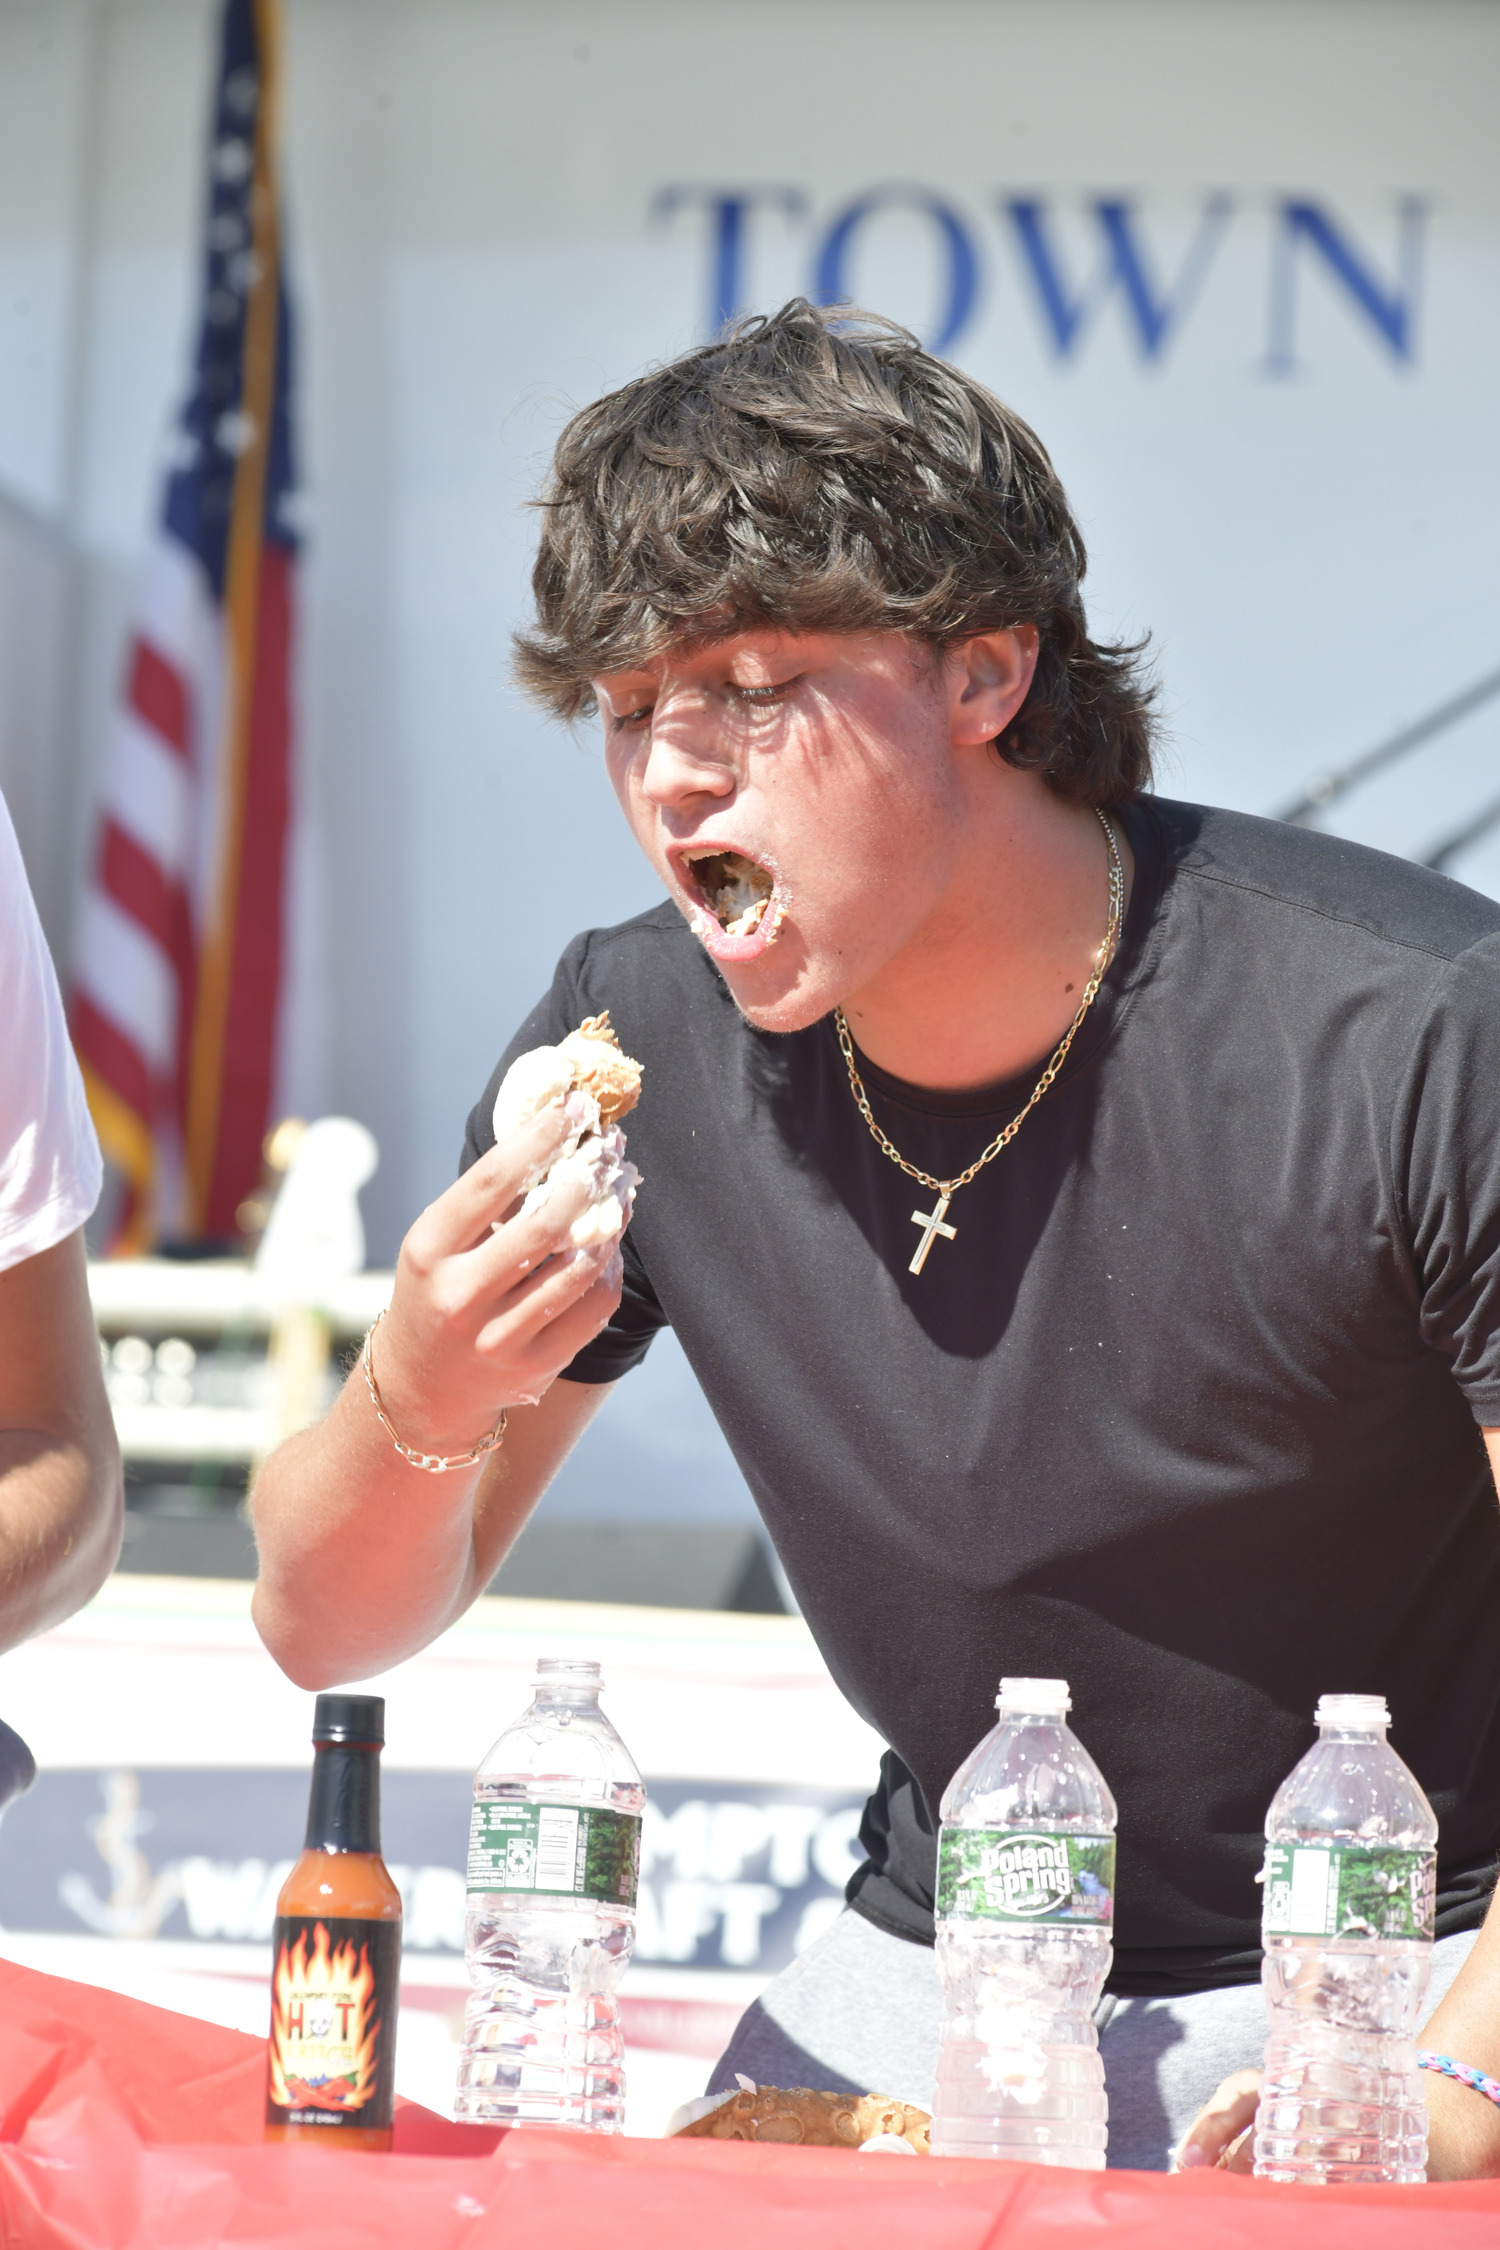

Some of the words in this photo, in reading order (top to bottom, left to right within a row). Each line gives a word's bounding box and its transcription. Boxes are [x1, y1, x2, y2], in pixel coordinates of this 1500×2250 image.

[644, 176, 1440, 384] TOWN
[638, 1799, 869, 1889] MPTO
[980, 1837, 1070, 1877] Poland
[983, 1866, 1072, 1908] Spring
